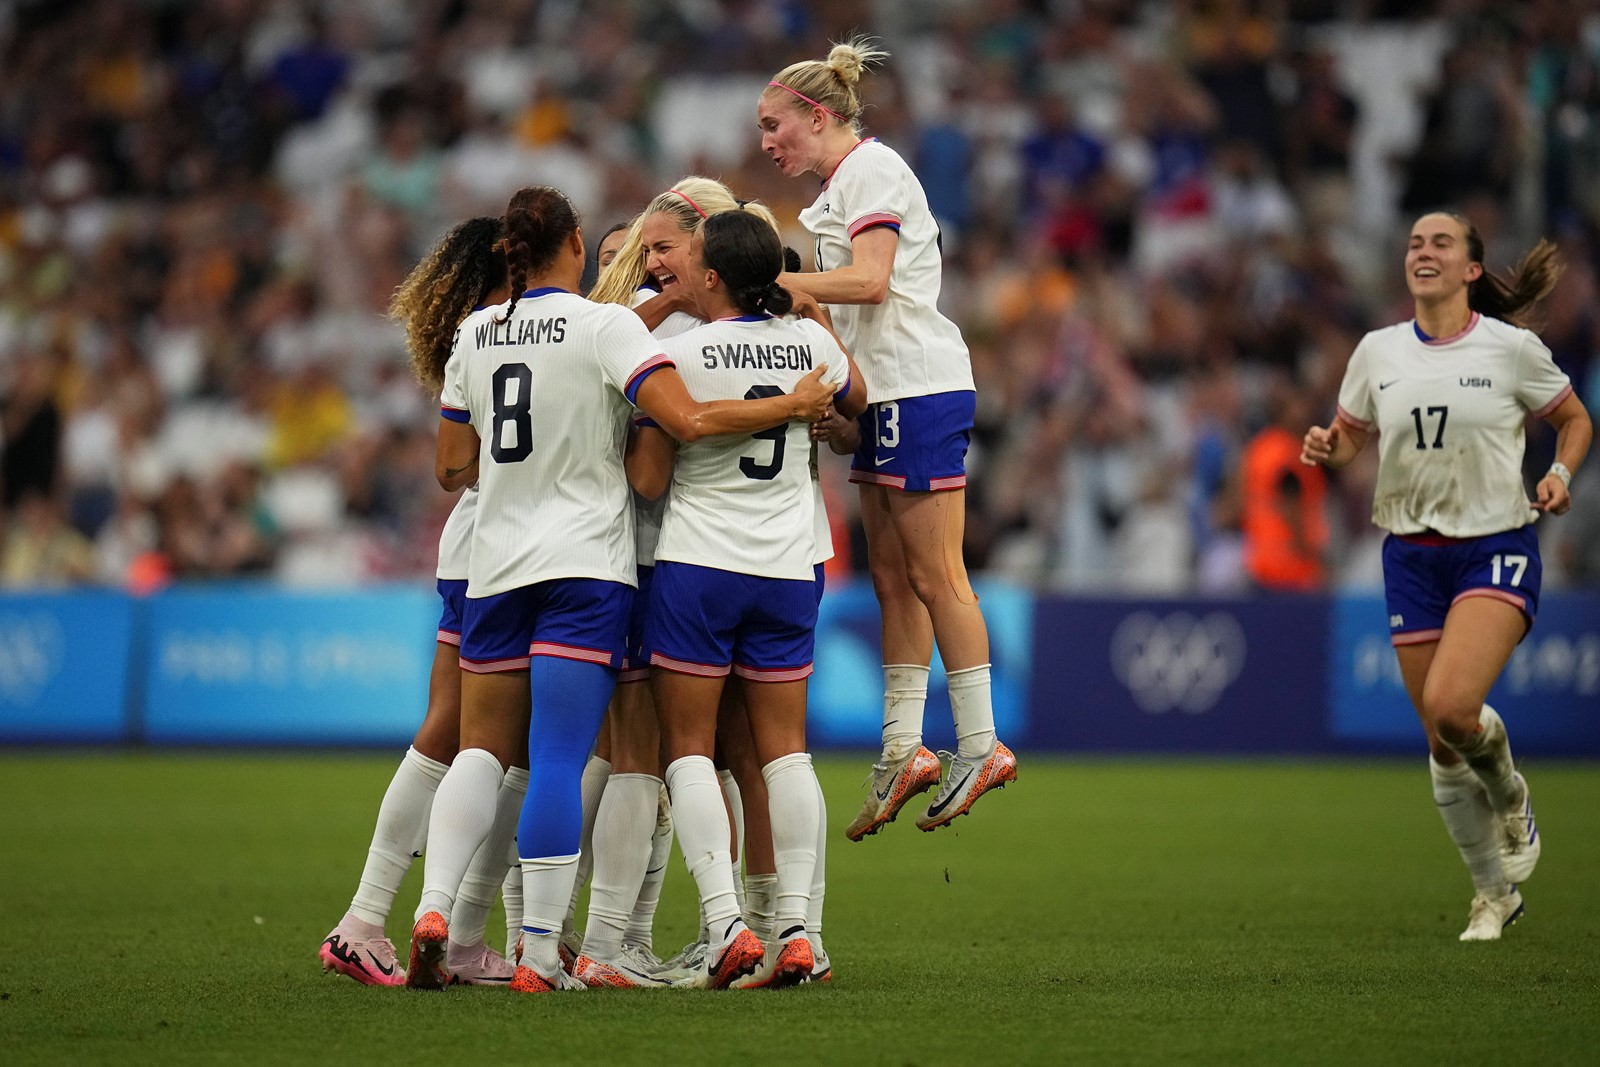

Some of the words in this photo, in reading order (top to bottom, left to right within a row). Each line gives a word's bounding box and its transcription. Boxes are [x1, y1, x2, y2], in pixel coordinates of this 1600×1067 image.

[475, 317, 567, 350] WILLIAMS
[703, 344, 812, 371] SWANSON
[1459, 377, 1492, 389] USA
[491, 363, 533, 464] 8
[1410, 406, 1448, 449] 17
[1490, 555, 1528, 587] 17
